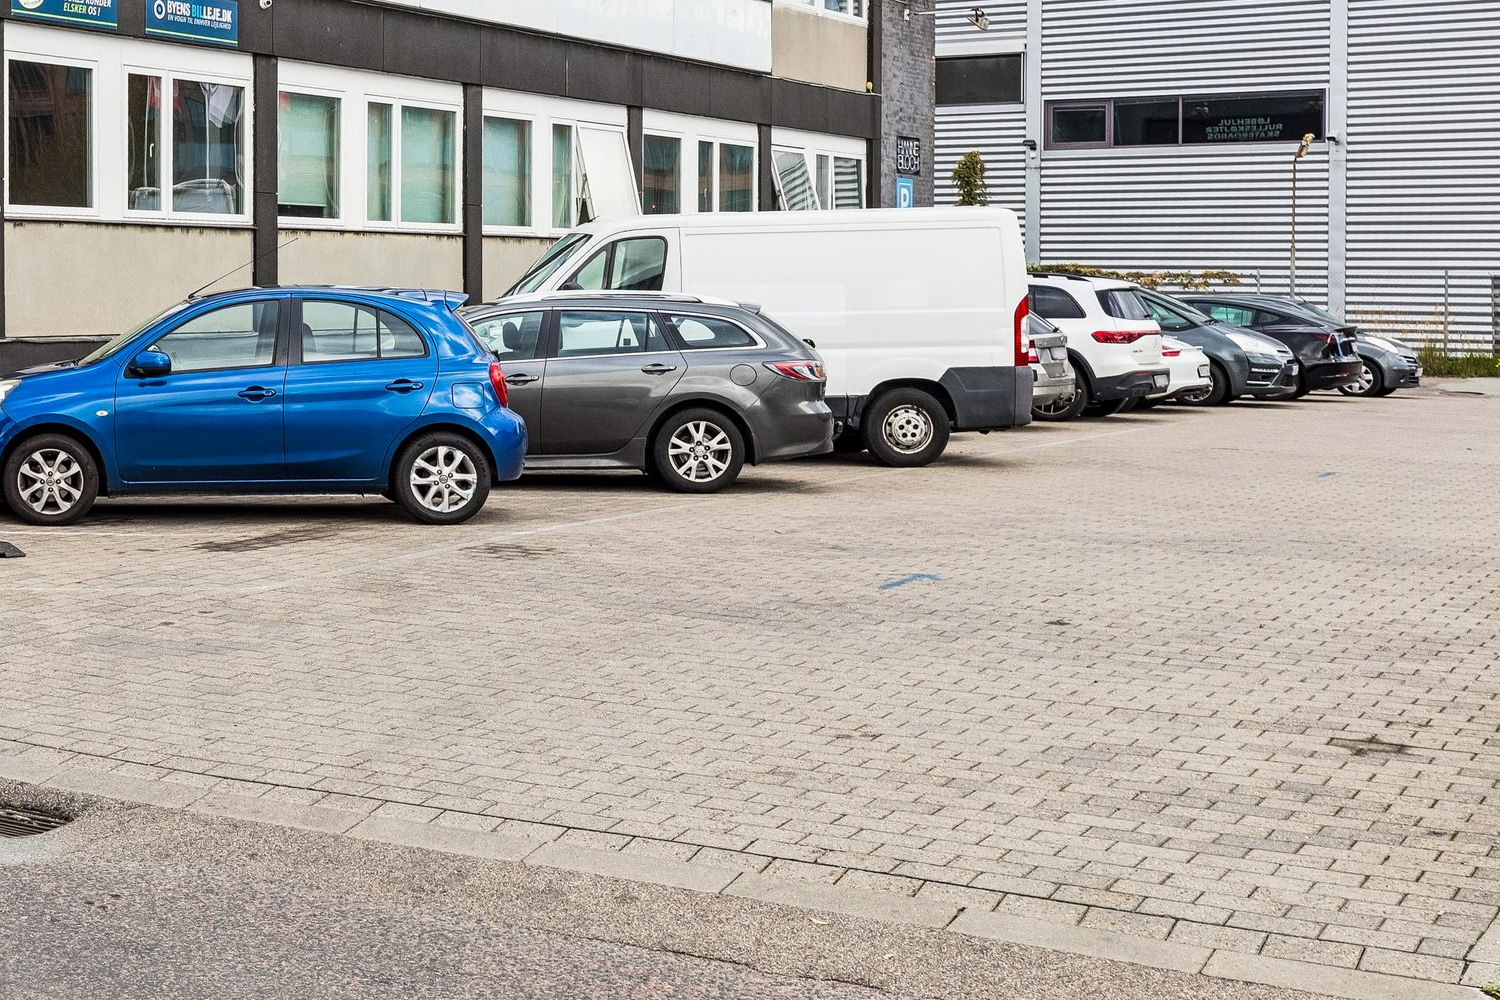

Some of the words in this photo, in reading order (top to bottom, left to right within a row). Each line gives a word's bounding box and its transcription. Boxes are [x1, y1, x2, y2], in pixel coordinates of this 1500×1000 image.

[63, 2, 87, 14] ELSKER
[167, 0, 190, 16] BYENS
[192, 4, 232, 23] BILLEJE.DK
